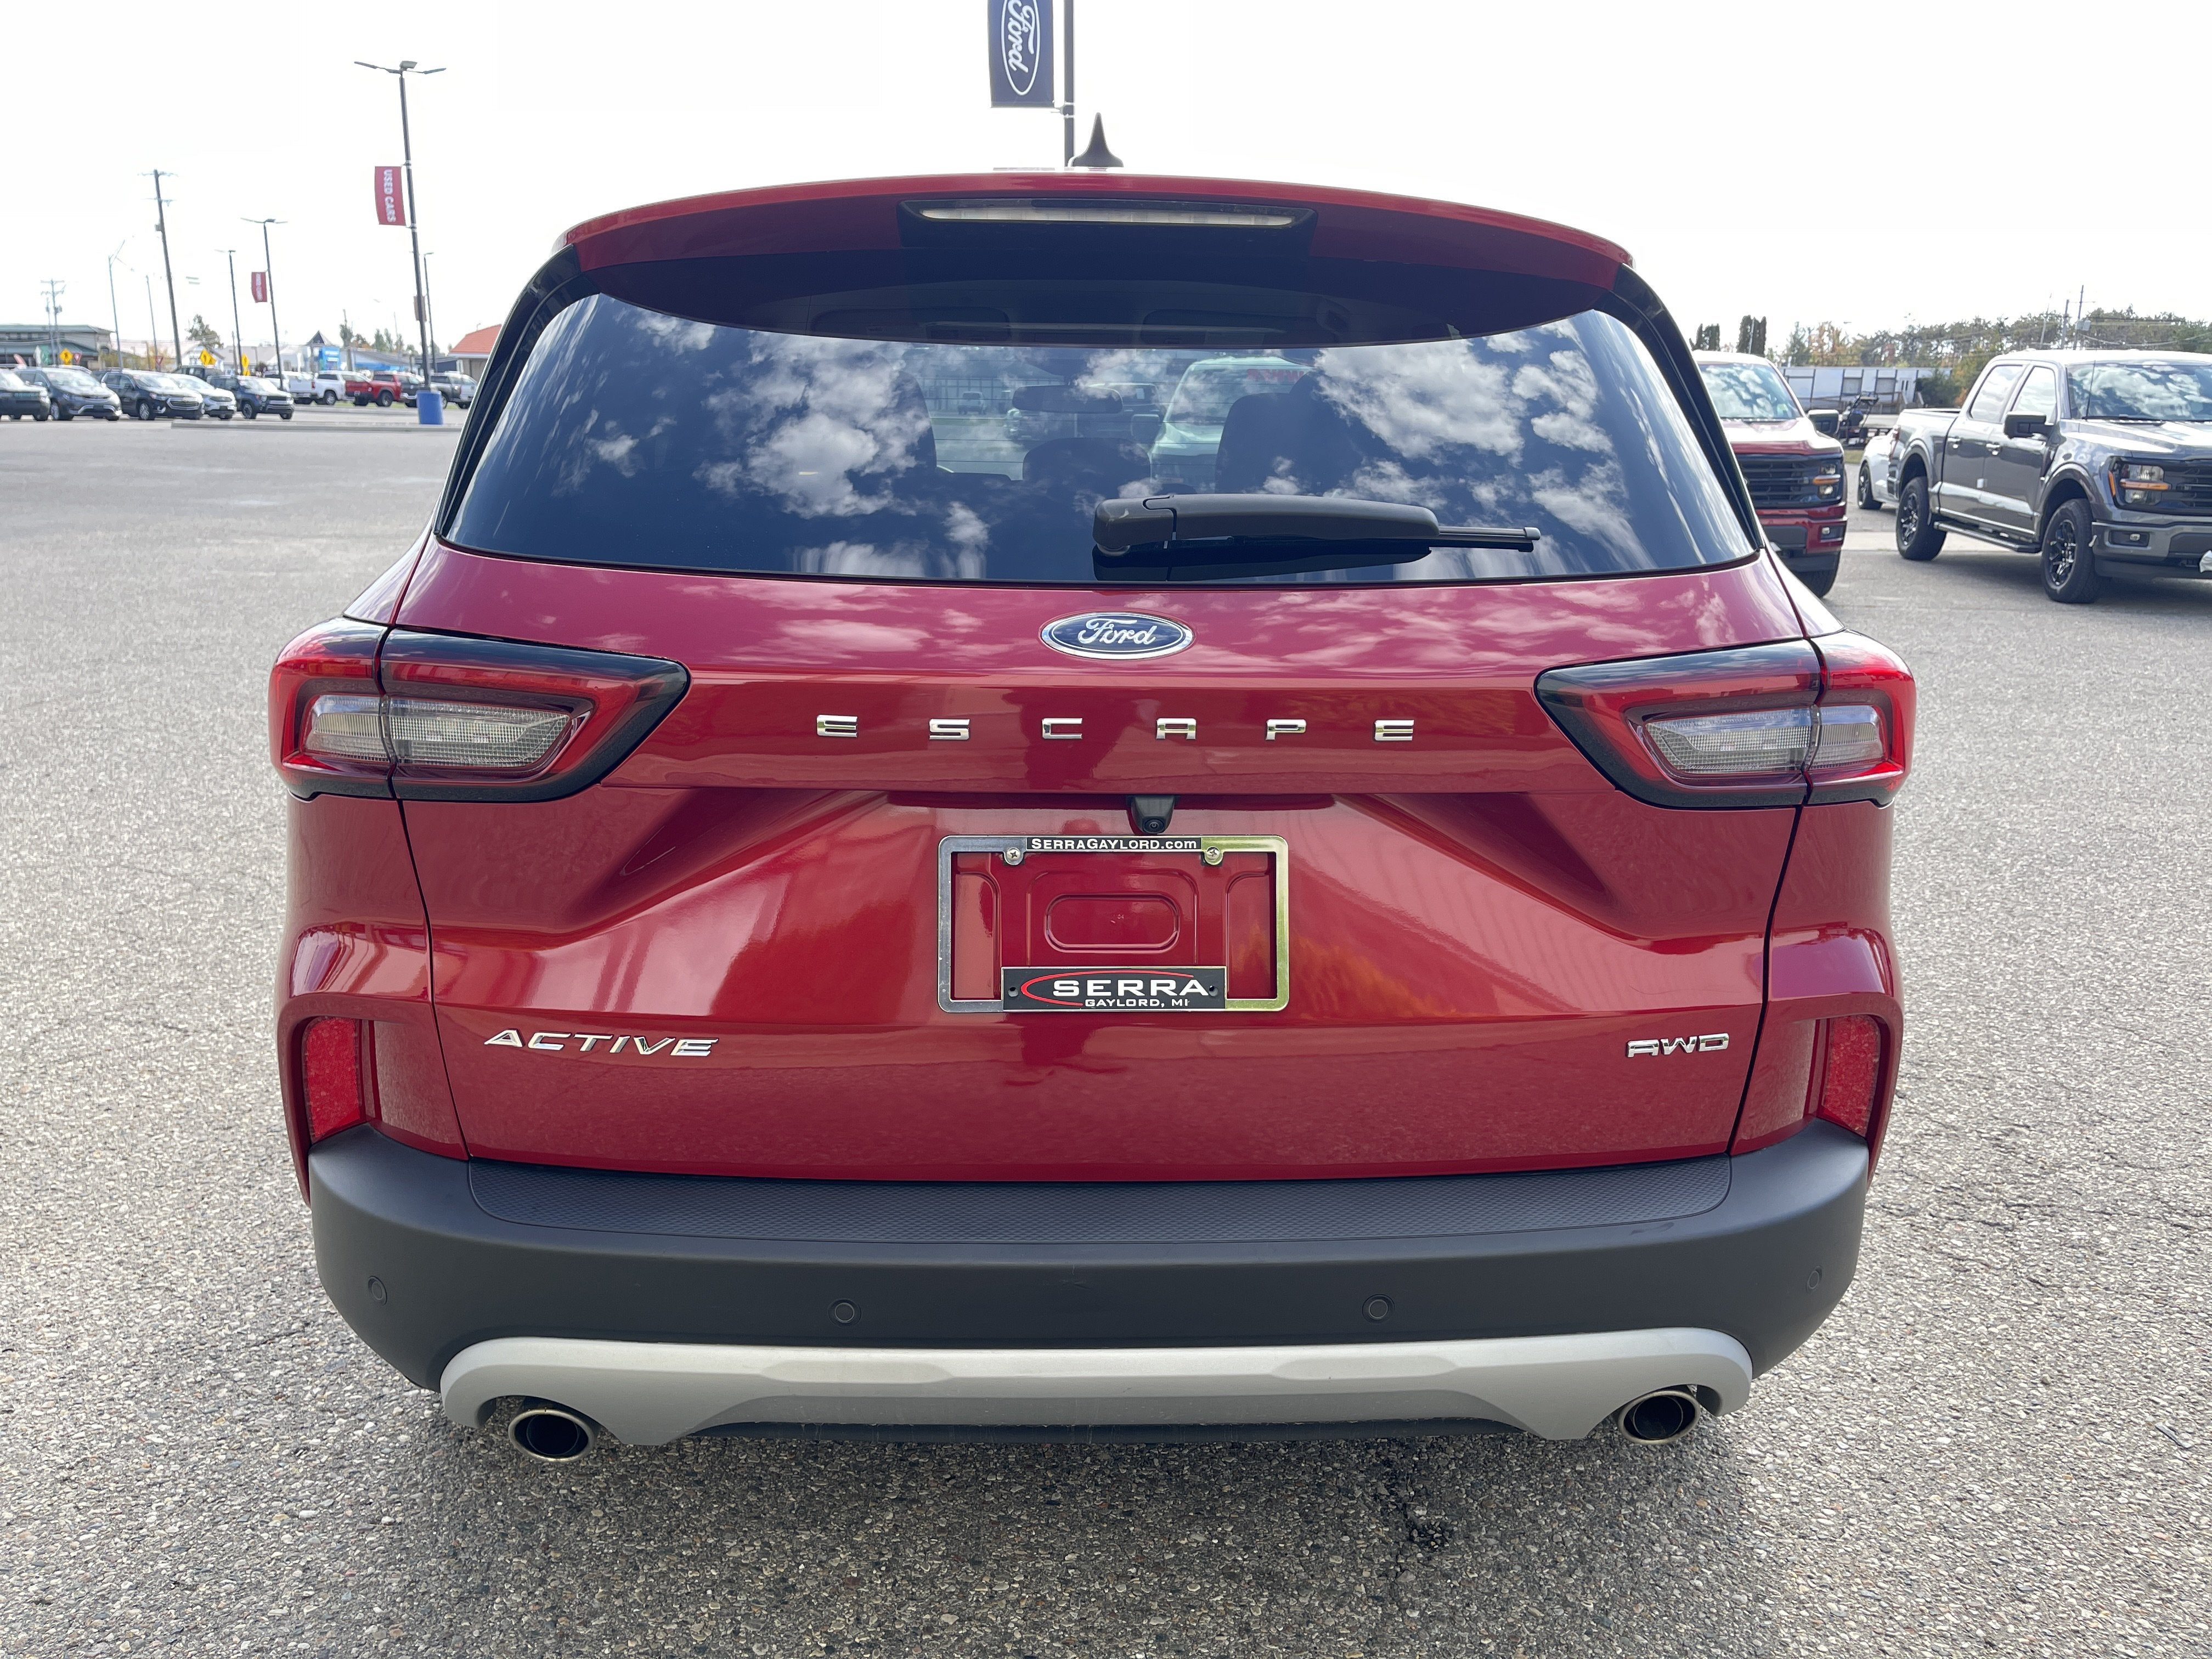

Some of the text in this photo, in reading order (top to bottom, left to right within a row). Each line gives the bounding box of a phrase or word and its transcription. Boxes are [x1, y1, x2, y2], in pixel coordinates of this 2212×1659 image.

[1007, 0, 1035, 73] Ford
[384, 169, 396, 222] USED CARS
[1077, 618, 1158, 645] Ford
[816, 714, 1414, 742] ESCAPE
[1053, 979, 1209, 996] SERRA
[1085, 998, 1165, 1008] GAYLORD,
[484, 1029, 719, 1056] ACTIVE
[1627, 1032, 1729, 1057] AWD
